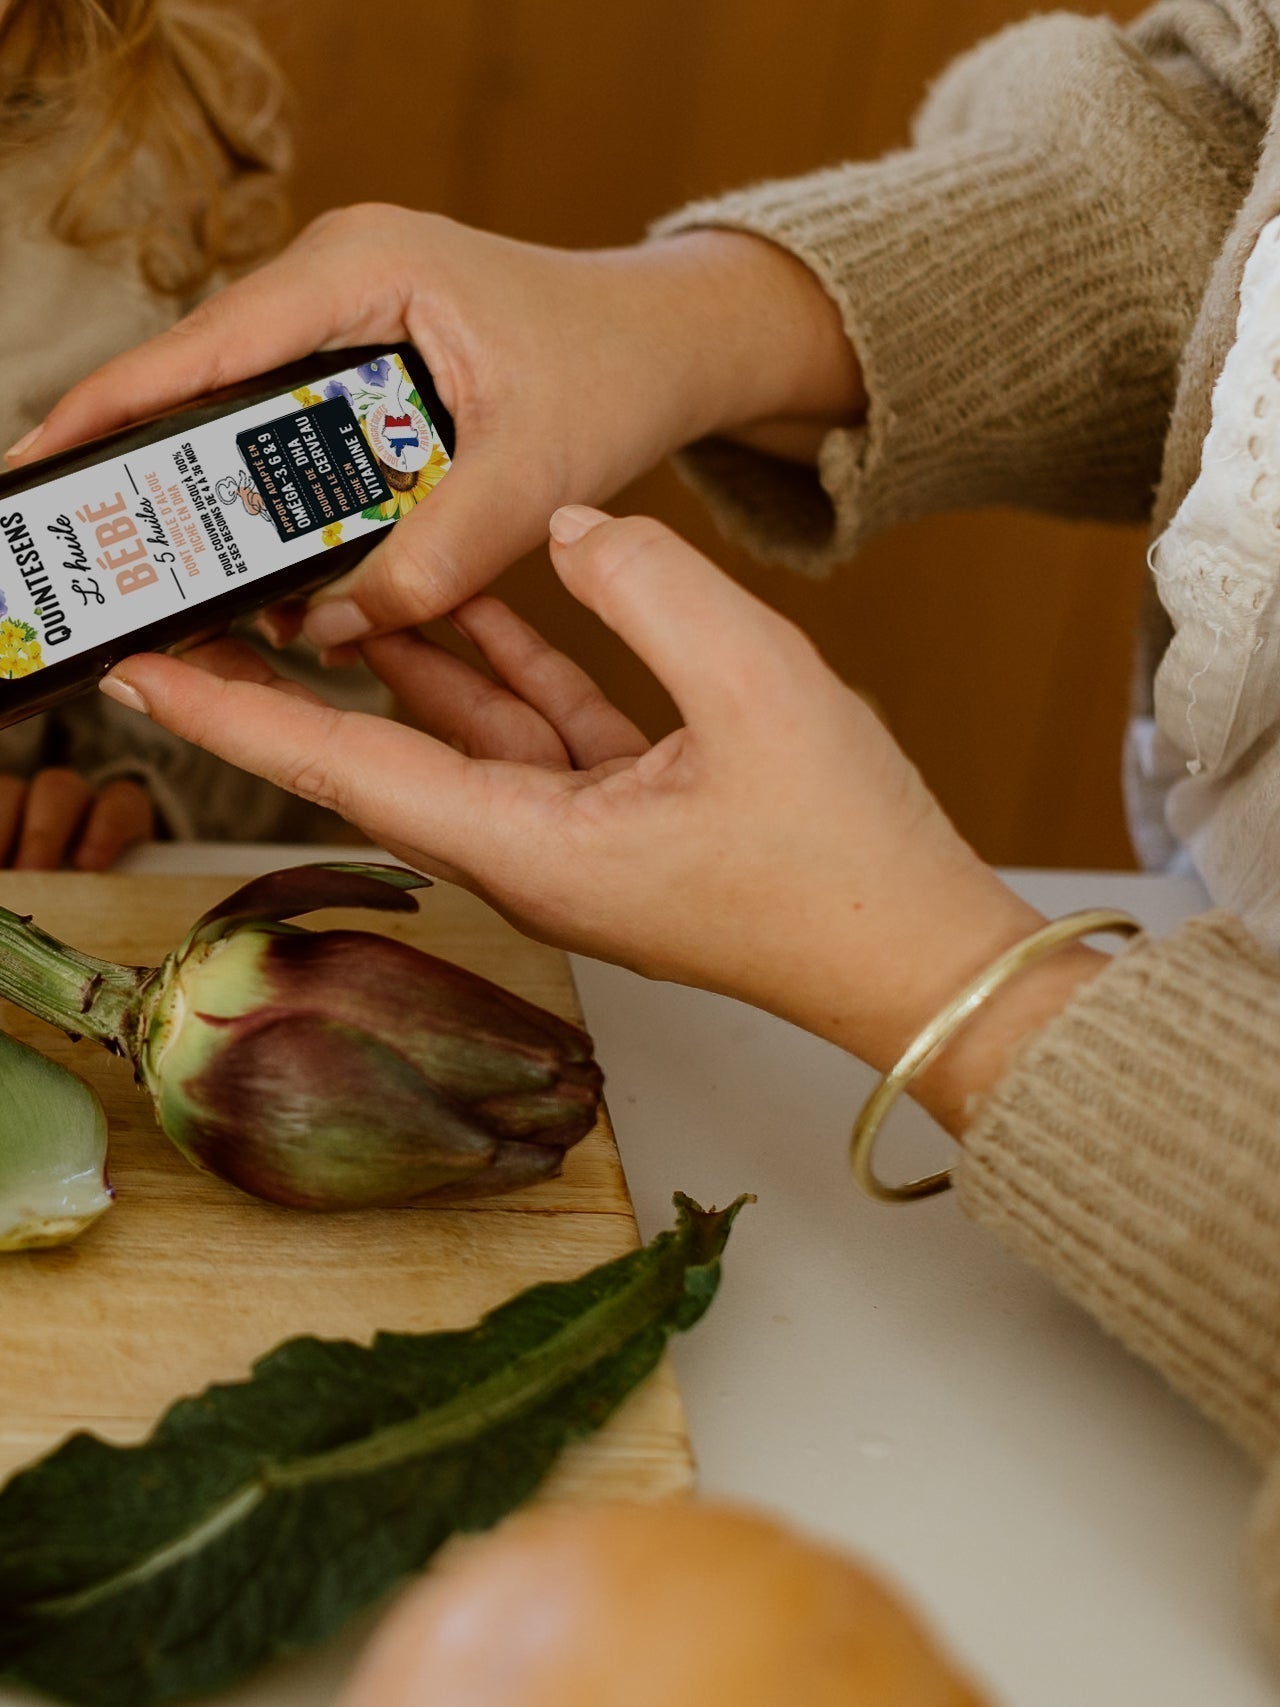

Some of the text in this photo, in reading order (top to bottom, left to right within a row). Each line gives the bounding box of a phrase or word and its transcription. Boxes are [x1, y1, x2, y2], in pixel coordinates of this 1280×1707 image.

[181, 442, 198, 464] MOIS
[191, 464, 203, 477] 36
[195, 477, 208, 488] À
[258, 433, 311, 528] OMÉGA-3, 6 & 9
[287, 438, 334, 518] SOURCE DE DHA
[295, 416, 350, 512] POUR LE CERVEAU
[339, 423, 383, 499] VITAMINE E
[343, 462, 369, 504] RICHE EN
[167, 484, 206, 554] RICHE EN DHA
[172, 451, 236, 577] POUR COUVRIR JUSQU'À 100%
[204, 493, 217, 506] DE
[248, 444, 295, 533] APPORT ADAPTÉ EN
[75, 491, 159, 596] BÉBÉ
[135, 497, 176, 563] 5 huiles
[144, 471, 200, 577] DONT HUILE D'ALGUE
[210, 506, 234, 543] BESOINS
[227, 543, 242, 561] SES
[0, 512, 72, 646] QUINTESENS
[235, 561, 248, 574] DE
